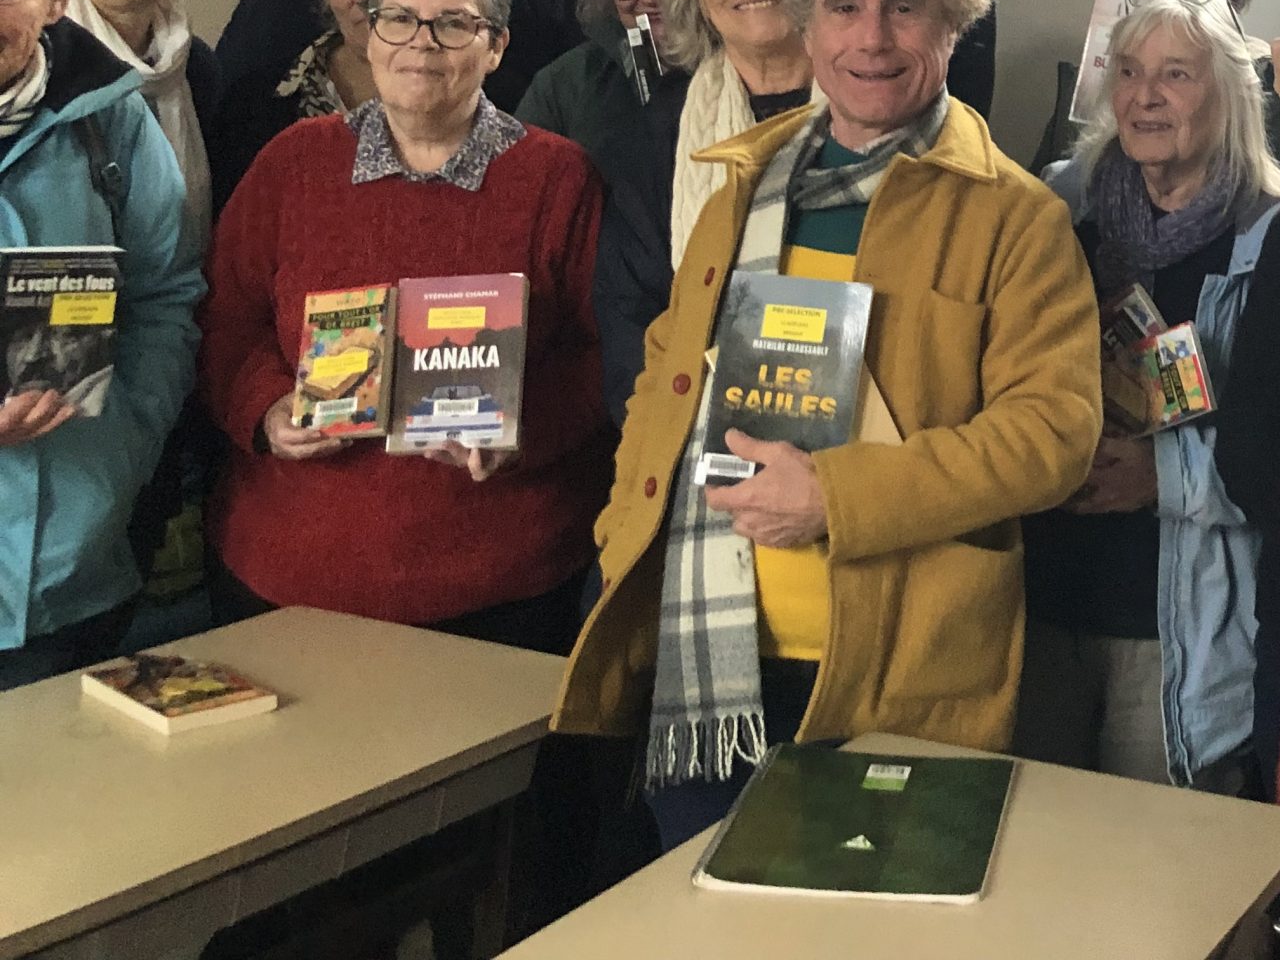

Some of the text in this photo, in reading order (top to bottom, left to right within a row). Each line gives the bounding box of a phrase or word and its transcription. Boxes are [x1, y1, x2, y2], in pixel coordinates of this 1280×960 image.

[7, 274, 115, 293] Le vent des fous
[413, 344, 500, 372] KANAKA
[758, 364, 813, 388] LES
[724, 386, 838, 418] SAULES
